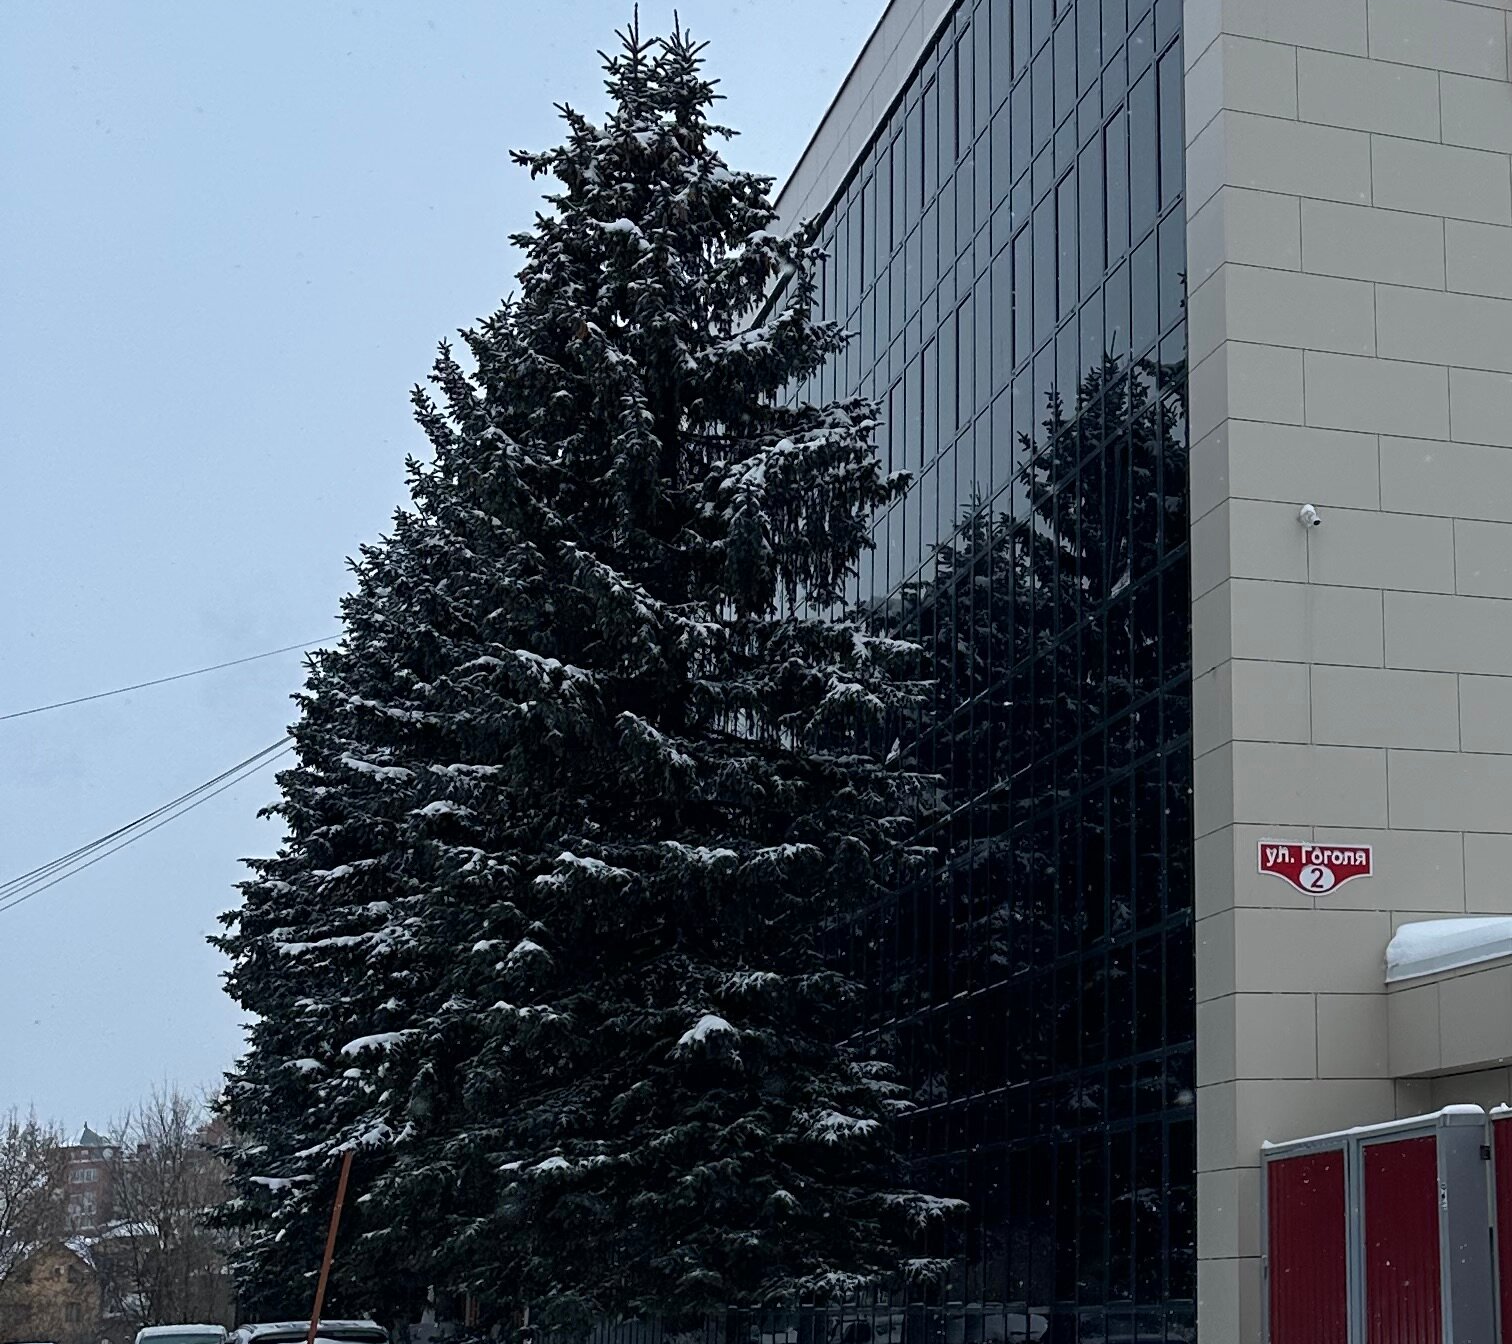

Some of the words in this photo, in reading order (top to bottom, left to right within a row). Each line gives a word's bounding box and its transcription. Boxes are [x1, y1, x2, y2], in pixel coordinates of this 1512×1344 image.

[1265, 846, 1295, 867] ул.
[1301, 846, 1366, 865] Гоголя
[1310, 867, 1324, 888] 2
